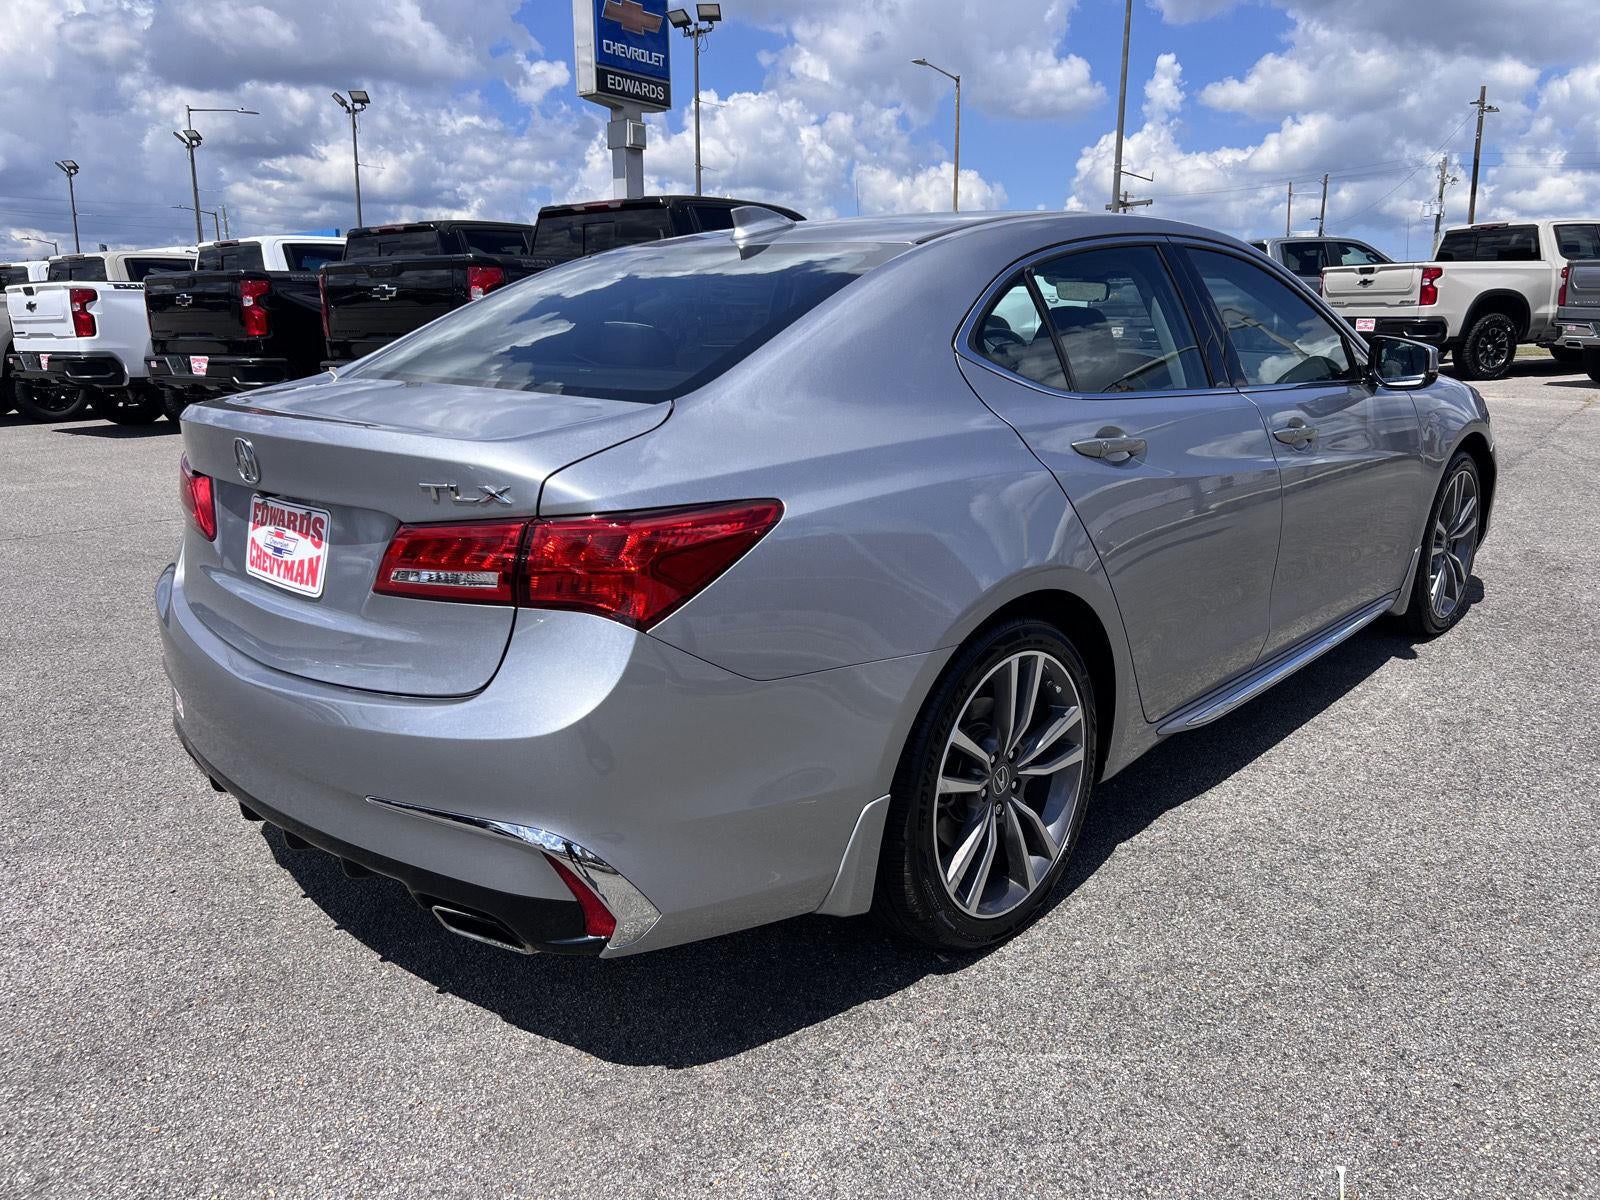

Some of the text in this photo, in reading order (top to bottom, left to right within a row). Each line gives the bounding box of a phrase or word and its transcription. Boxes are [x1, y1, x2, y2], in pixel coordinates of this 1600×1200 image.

[603, 40, 664, 67] CHEVROLET
[607, 74, 665, 100] EDWARDS
[418, 482, 512, 504] TLX
[252, 501, 325, 549] EDWARDS
[249, 537, 321, 588] CHEVYMAN
